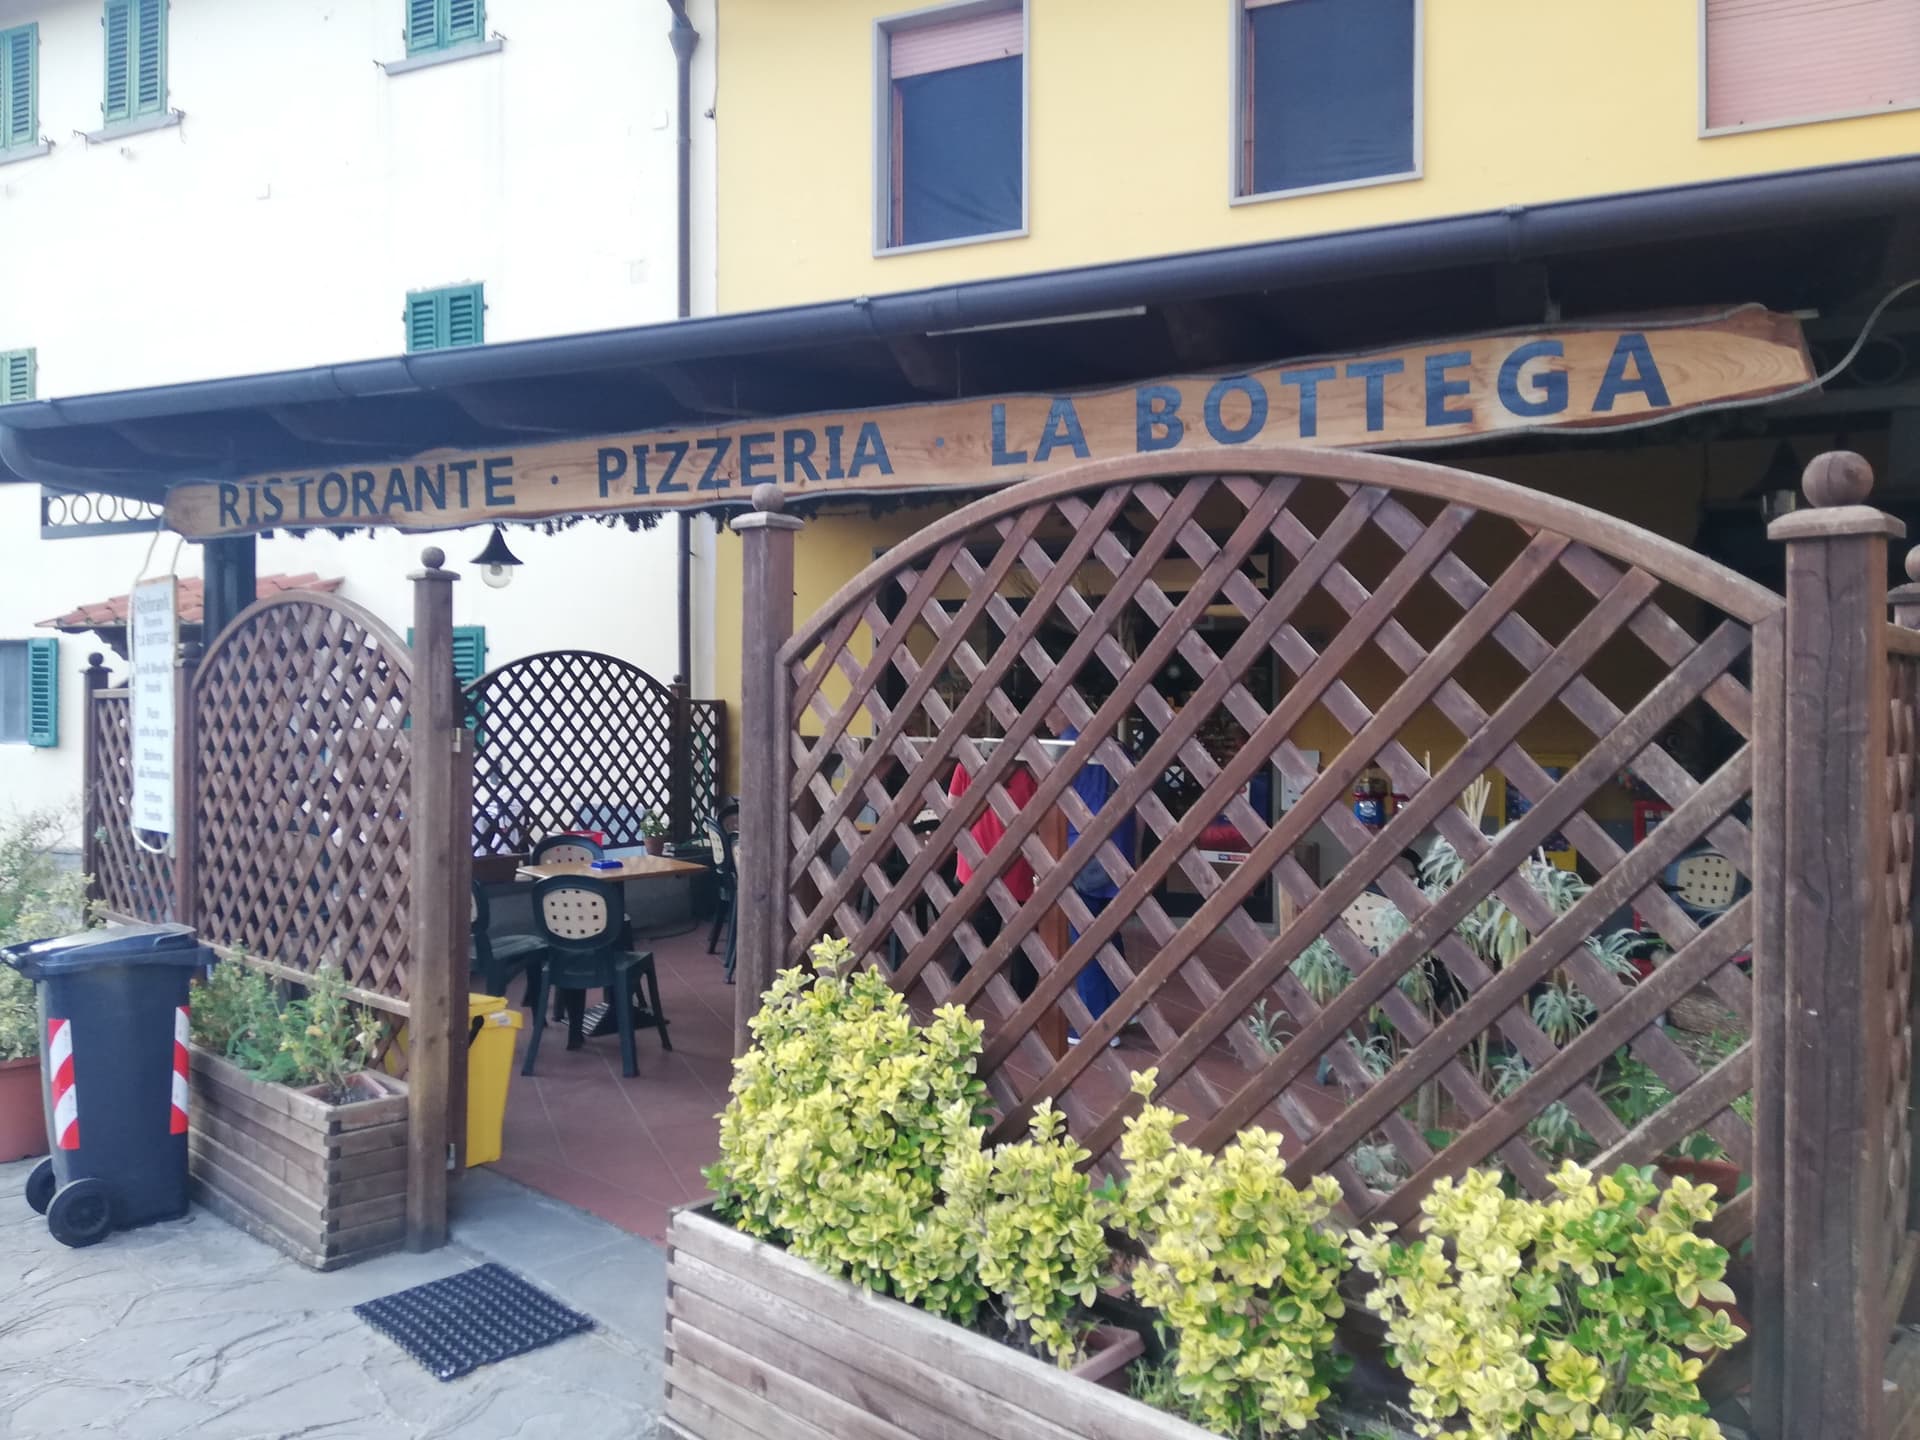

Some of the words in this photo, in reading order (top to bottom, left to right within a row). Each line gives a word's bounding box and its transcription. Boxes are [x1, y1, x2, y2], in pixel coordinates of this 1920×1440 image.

[218, 457, 515, 527] RISTORANTE
[597, 421, 894, 498] PIZZERIA
[991, 396, 1091, 466] LA
[1136, 333, 1671, 453] BOTTEGA
